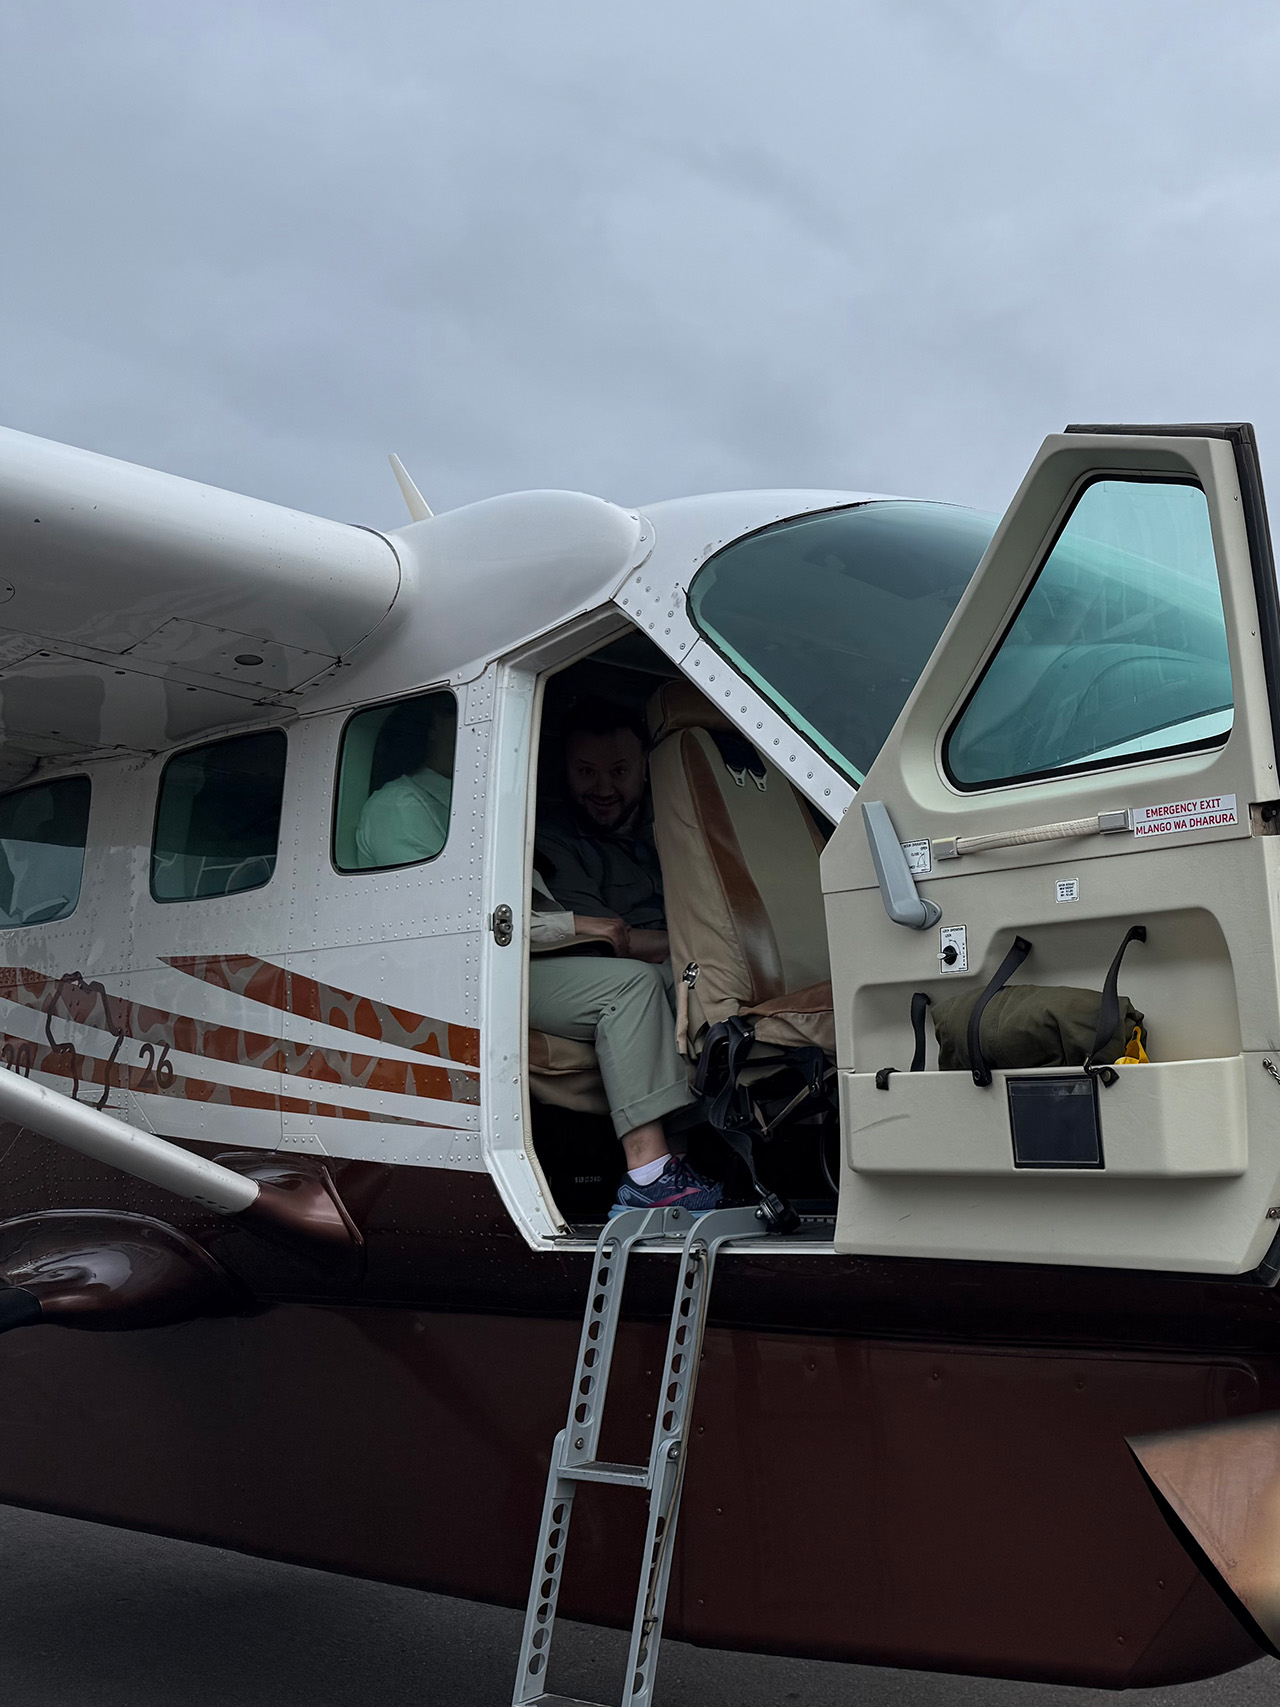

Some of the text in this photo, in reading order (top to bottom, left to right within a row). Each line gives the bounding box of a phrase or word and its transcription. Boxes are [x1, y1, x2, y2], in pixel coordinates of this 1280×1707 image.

[1145, 798, 1221, 819] EMERGENCY EXIT
[1135, 813, 1236, 836] MLANGO WA DHARURA
[138, 1042, 174, 1090] 26
